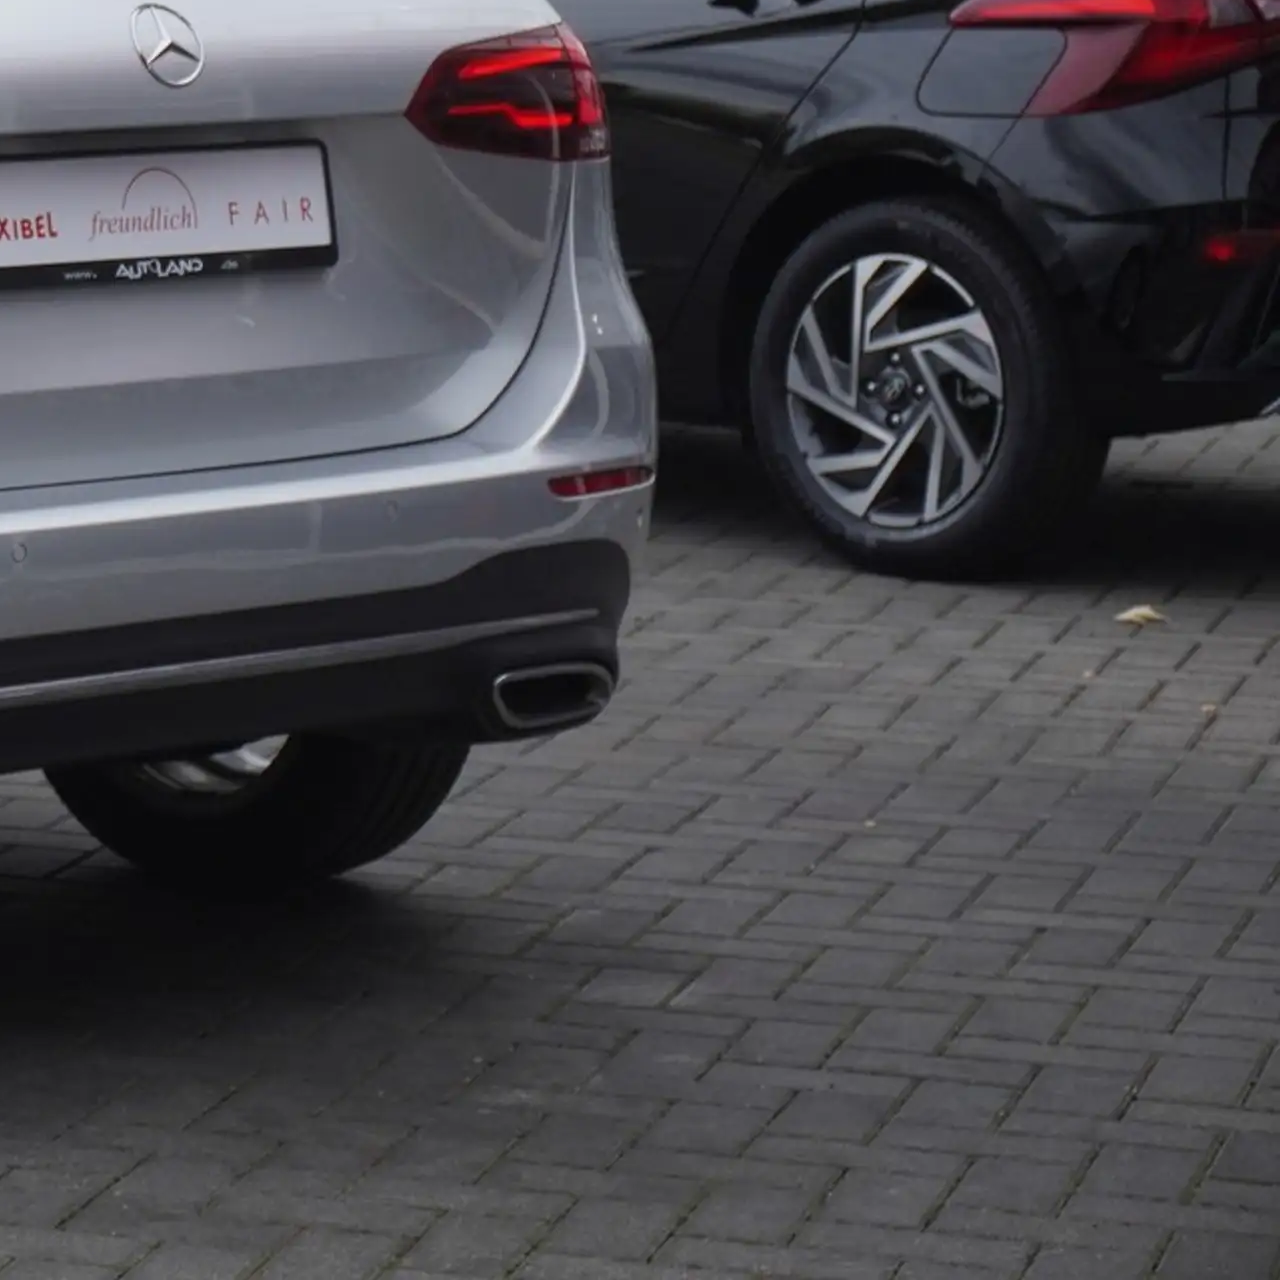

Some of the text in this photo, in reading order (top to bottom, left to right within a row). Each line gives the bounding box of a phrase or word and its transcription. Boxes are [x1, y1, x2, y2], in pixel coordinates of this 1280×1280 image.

[88, 205, 193, 242] freundlich
[227, 196, 315, 227] FAIR
[114, 257, 204, 280] AUTOLAND
